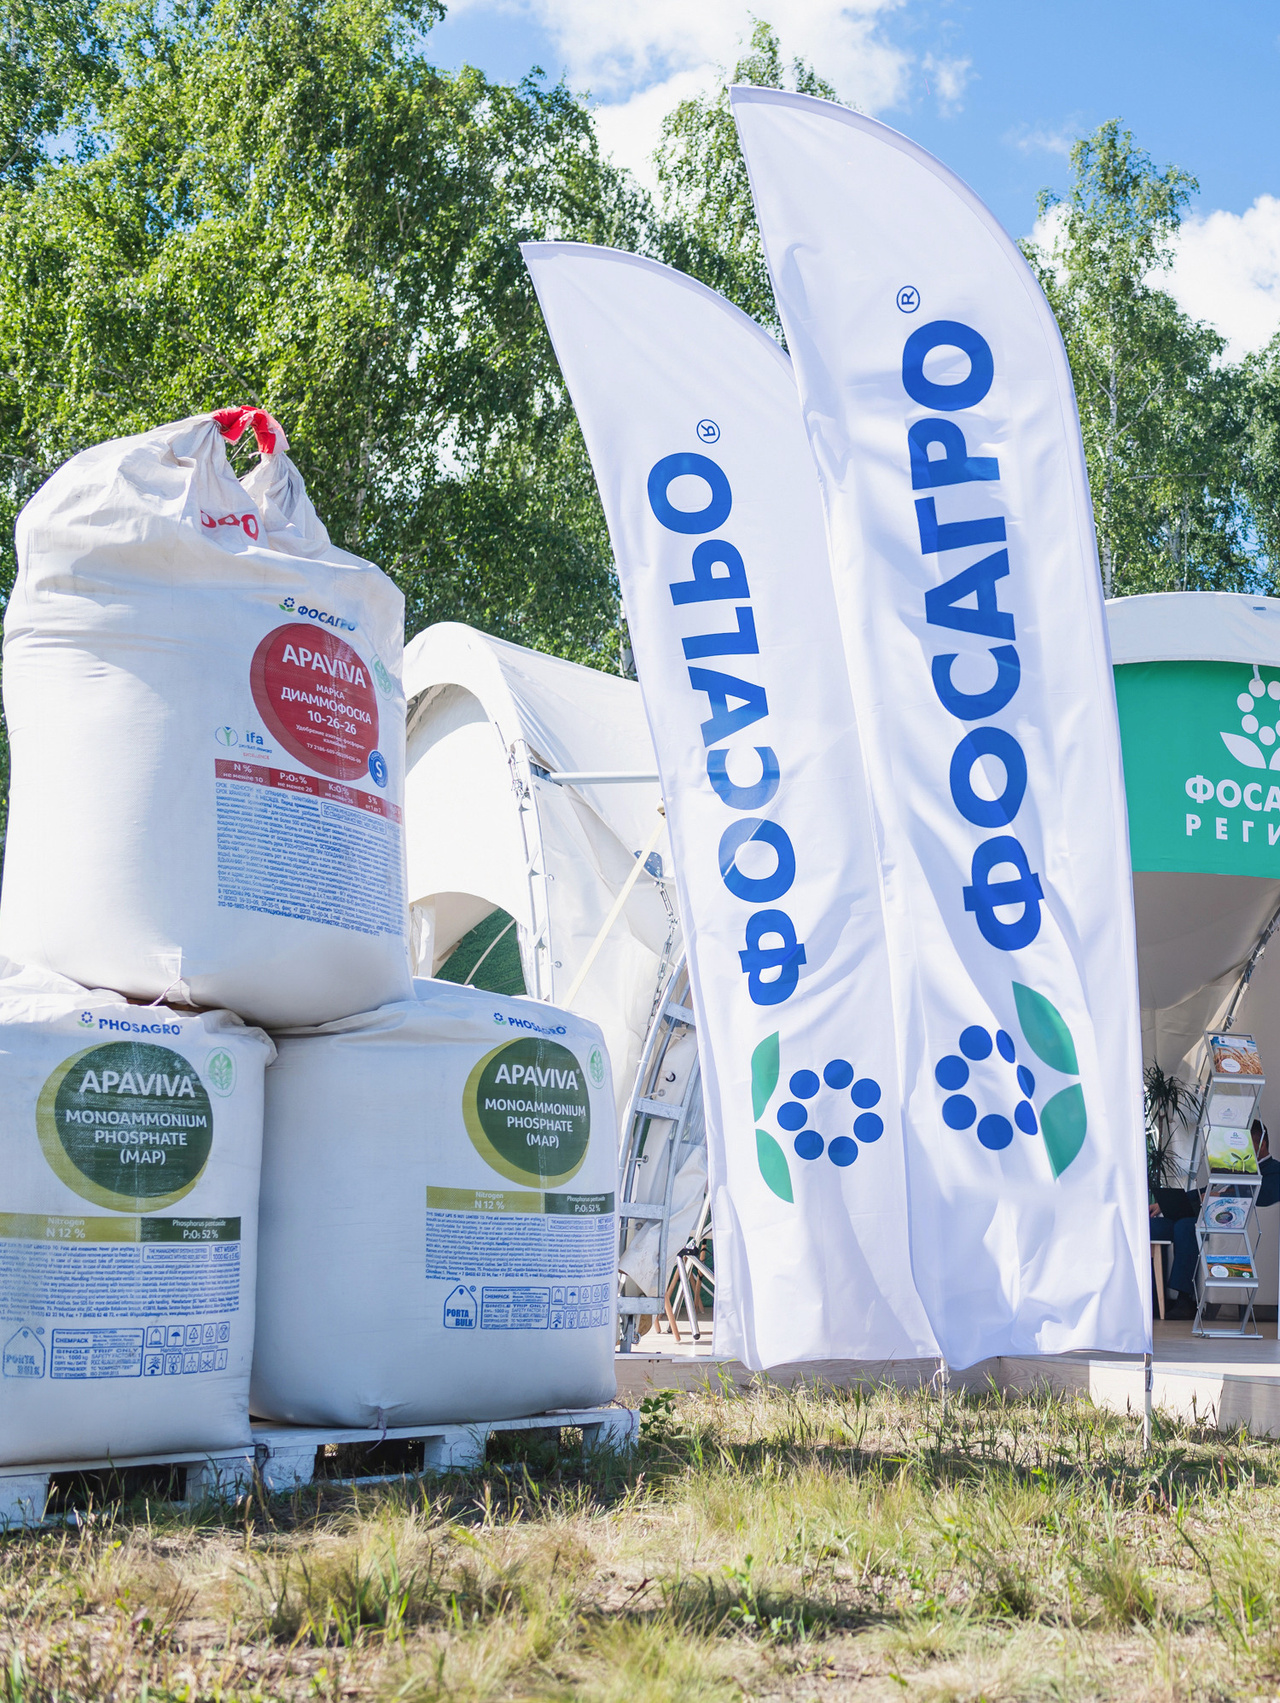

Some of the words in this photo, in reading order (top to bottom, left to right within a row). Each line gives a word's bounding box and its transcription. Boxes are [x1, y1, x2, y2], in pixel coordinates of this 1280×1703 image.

[901, 320, 1045, 951] ФОСАГРО
[282, 643, 367, 689] APAVIVA
[316, 684, 346, 700] МАРКА
[280, 686, 372, 725] ДИАММОФОСКА
[307, 710, 357, 735] 10-26-26
[246, 730, 263, 745] ifa
[233, 763, 241, 771] N
[242, 764, 252, 773] %
[298, 775, 307, 785] %
[98, 1018, 181, 1036] PHOSAGRO
[508, 1016, 567, 1036] PHOSAGRO
[79, 1070, 196, 1098] APAVIVA
[494, 1063, 579, 1091] APAVIVA
[485, 1098, 586, 1117] MONOAMMONIUM
[65, 1109, 207, 1128] MONOAMMONIUM
[506, 1115, 573, 1133] PHOSPHATE
[94, 1130, 188, 1146] PHOSPHATE
[526, 1132, 560, 1149] (MAP)
[120, 1150, 166, 1166] (MAP)
[475, 1191, 504, 1200] Nitrogen
[474, 1200, 482, 1209] N
[483, 1200, 495, 1209] 12
[495, 1201, 505, 1210] %
[588, 1204, 596, 1213] 52
[48, 1217, 85, 1228] Nitrogen
[172, 1219, 203, 1229] Phosphorus
[46, 1228, 57, 1238] N
[58, 1228, 73, 1239] 12
[74, 1228, 86, 1239] %
[201, 1230, 211, 1239] 52
[211, 1230, 219, 1239] %
[446, 1308, 470, 1318] PORTA
[455, 1318, 474, 1327] BULK
